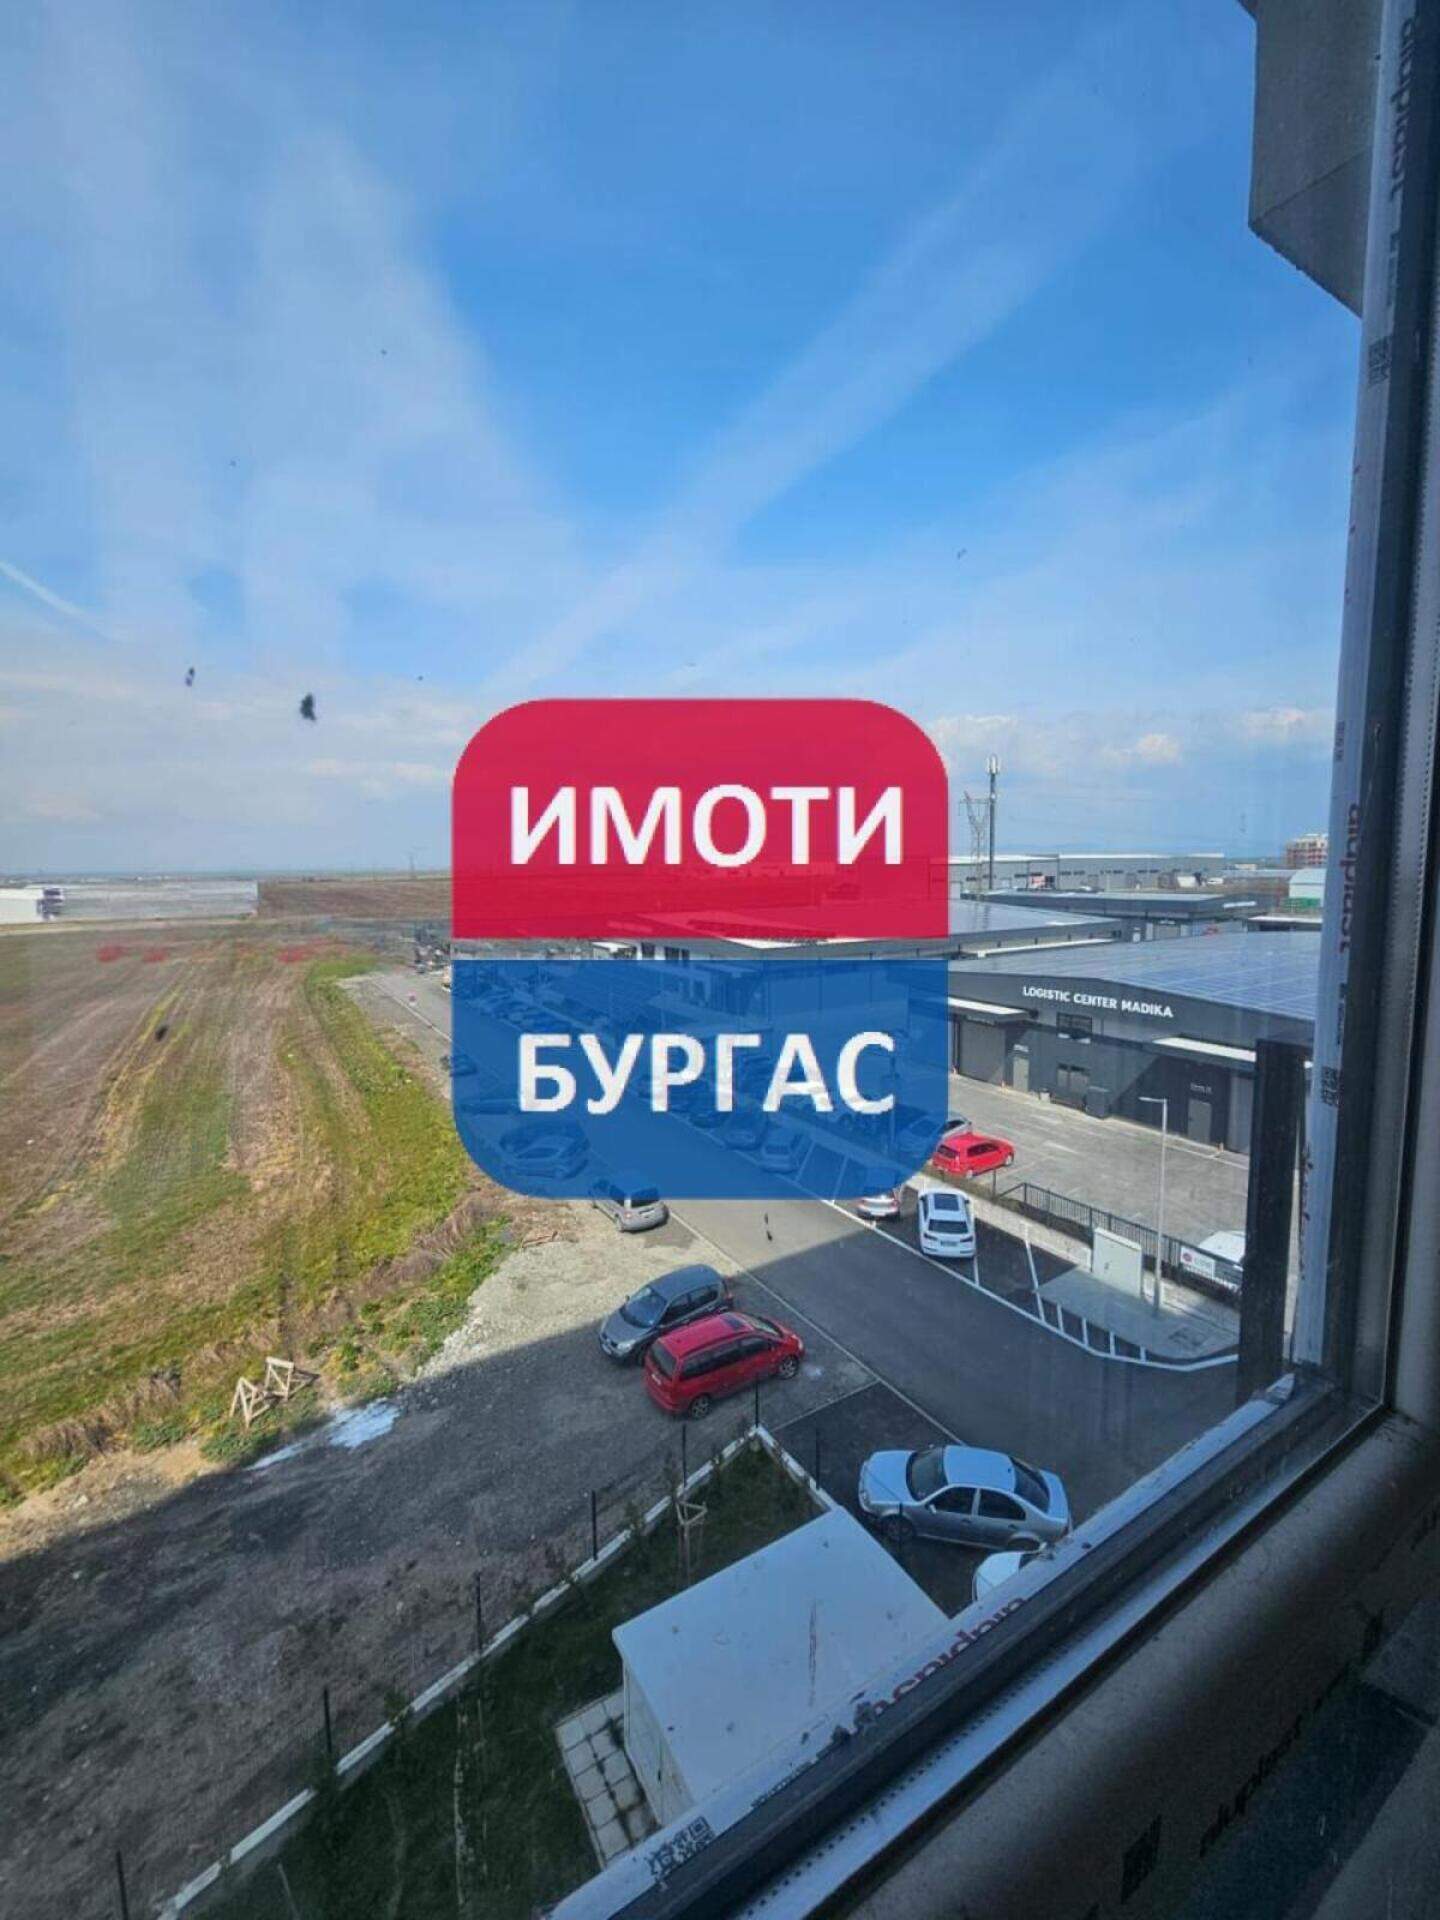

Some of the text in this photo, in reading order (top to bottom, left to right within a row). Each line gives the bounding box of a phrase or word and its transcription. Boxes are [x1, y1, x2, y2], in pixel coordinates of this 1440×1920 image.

[1022, 986, 1174, 1018] LOGISTIC CENTER MADIKA
